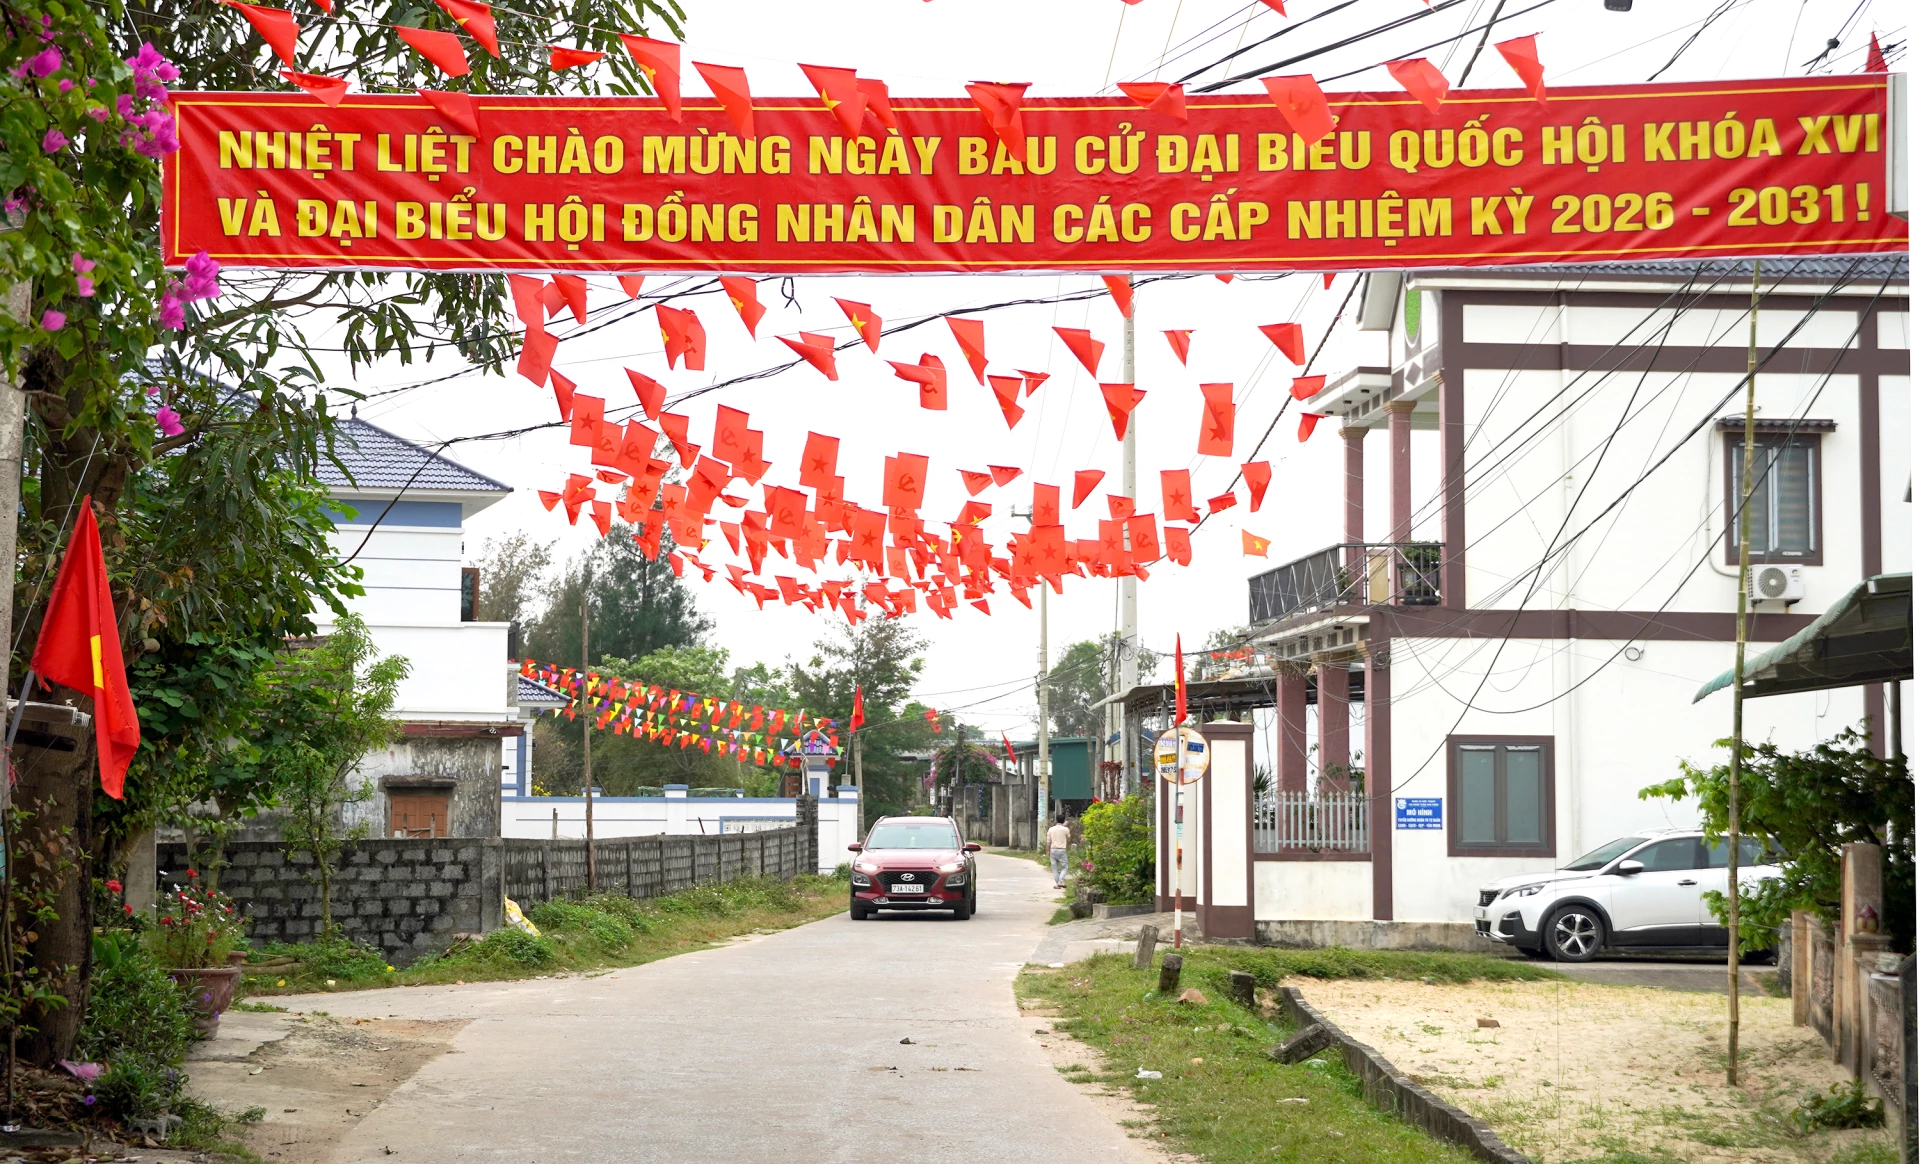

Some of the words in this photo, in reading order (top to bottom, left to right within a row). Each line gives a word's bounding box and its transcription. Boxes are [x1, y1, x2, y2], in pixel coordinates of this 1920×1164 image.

[217, 123, 362, 180] NHIỆT
[376, 125, 477, 182] LIỆT
[492, 127, 625, 175] CHÀO
[642, 127, 791, 175] MỪNG
[809, 127, 942, 175] NGÀY
[1074, 122, 1146, 175] CỬ
[1155, 132, 1239, 182] ĐẠI
[1389, 113, 1524, 174] QUỐC
[1541, 116, 1625, 173] HỘI
[1643, 111, 1784, 163] KHÓA
[1798, 113, 1880, 155] XVI
[217, 190, 281, 237] VÀ
[296, 198, 378, 247] ĐẠI
[395, 186, 506, 241] BIỂU
[524, 195, 605, 251] HỘI
[621, 190, 759, 243] ĐỒNG
[776, 195, 915, 243] NHÂN
[933, 196, 1035, 244] DÂN
[1053, 195, 1152, 243] CÁC
[1170, 188, 1269, 242] CẤP
[1287, 190, 1453, 247] NHIỆM
[1471, 187, 1536, 236] KỲ
[1551, 191, 1675, 234] 2026
[1692, 207, 1710, 216] -
[1727, 182, 1870, 227] 2031!
